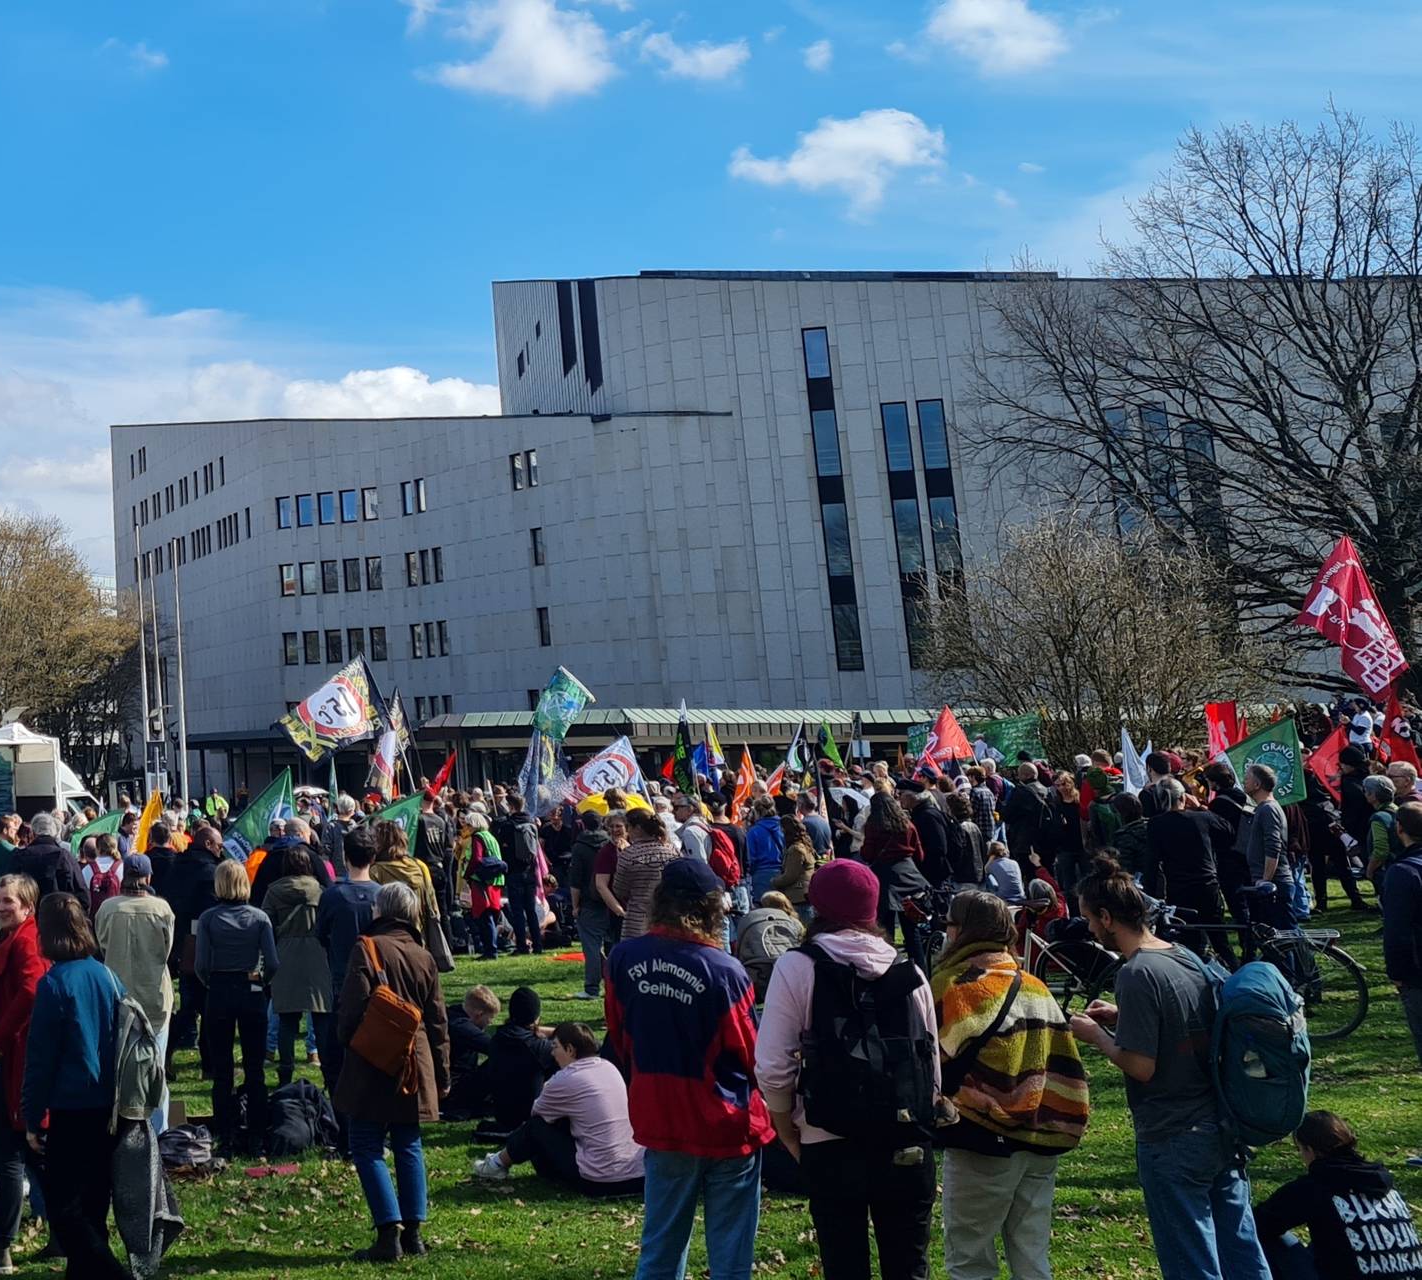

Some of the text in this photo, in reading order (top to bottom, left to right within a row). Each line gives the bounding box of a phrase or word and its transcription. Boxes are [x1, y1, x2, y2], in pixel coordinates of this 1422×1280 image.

[627, 957, 707, 994] FSV Alemannia
[638, 979, 693, 1005] Geithain
